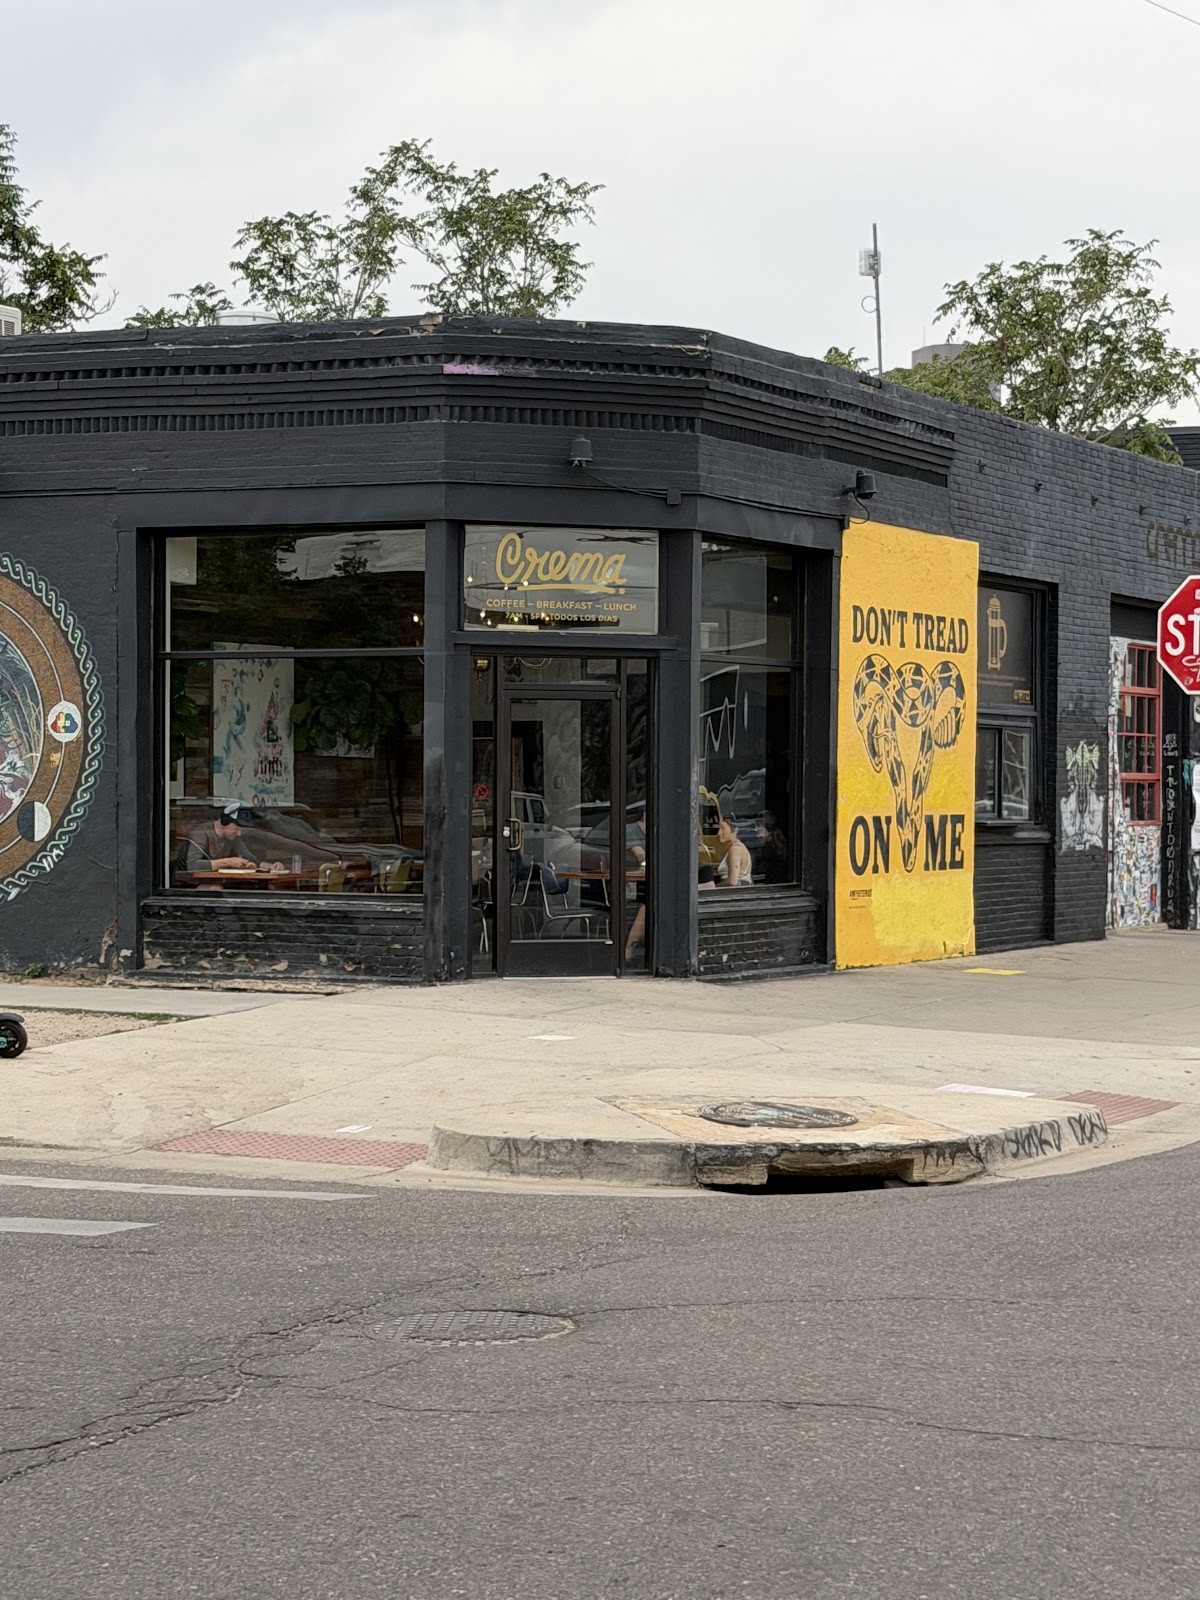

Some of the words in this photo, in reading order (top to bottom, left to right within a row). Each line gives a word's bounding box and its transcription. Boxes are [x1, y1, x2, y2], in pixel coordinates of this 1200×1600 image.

[495, 532, 628, 585] Crema
[486, 599, 526, 608] COFFEE
[536, 600, 593, 610] BREAKFAST
[603, 602, 637, 611] LUNCH
[549, 613, 578, 622] TODOS
[580, 614, 596, 622] LOS
[598, 615, 618, 623] DIAS
[852, 604, 908, 649] DON'T
[912, 612, 969, 654] TREAD
[849, 815, 892, 876] ON
[924, 814, 965, 872] ME
